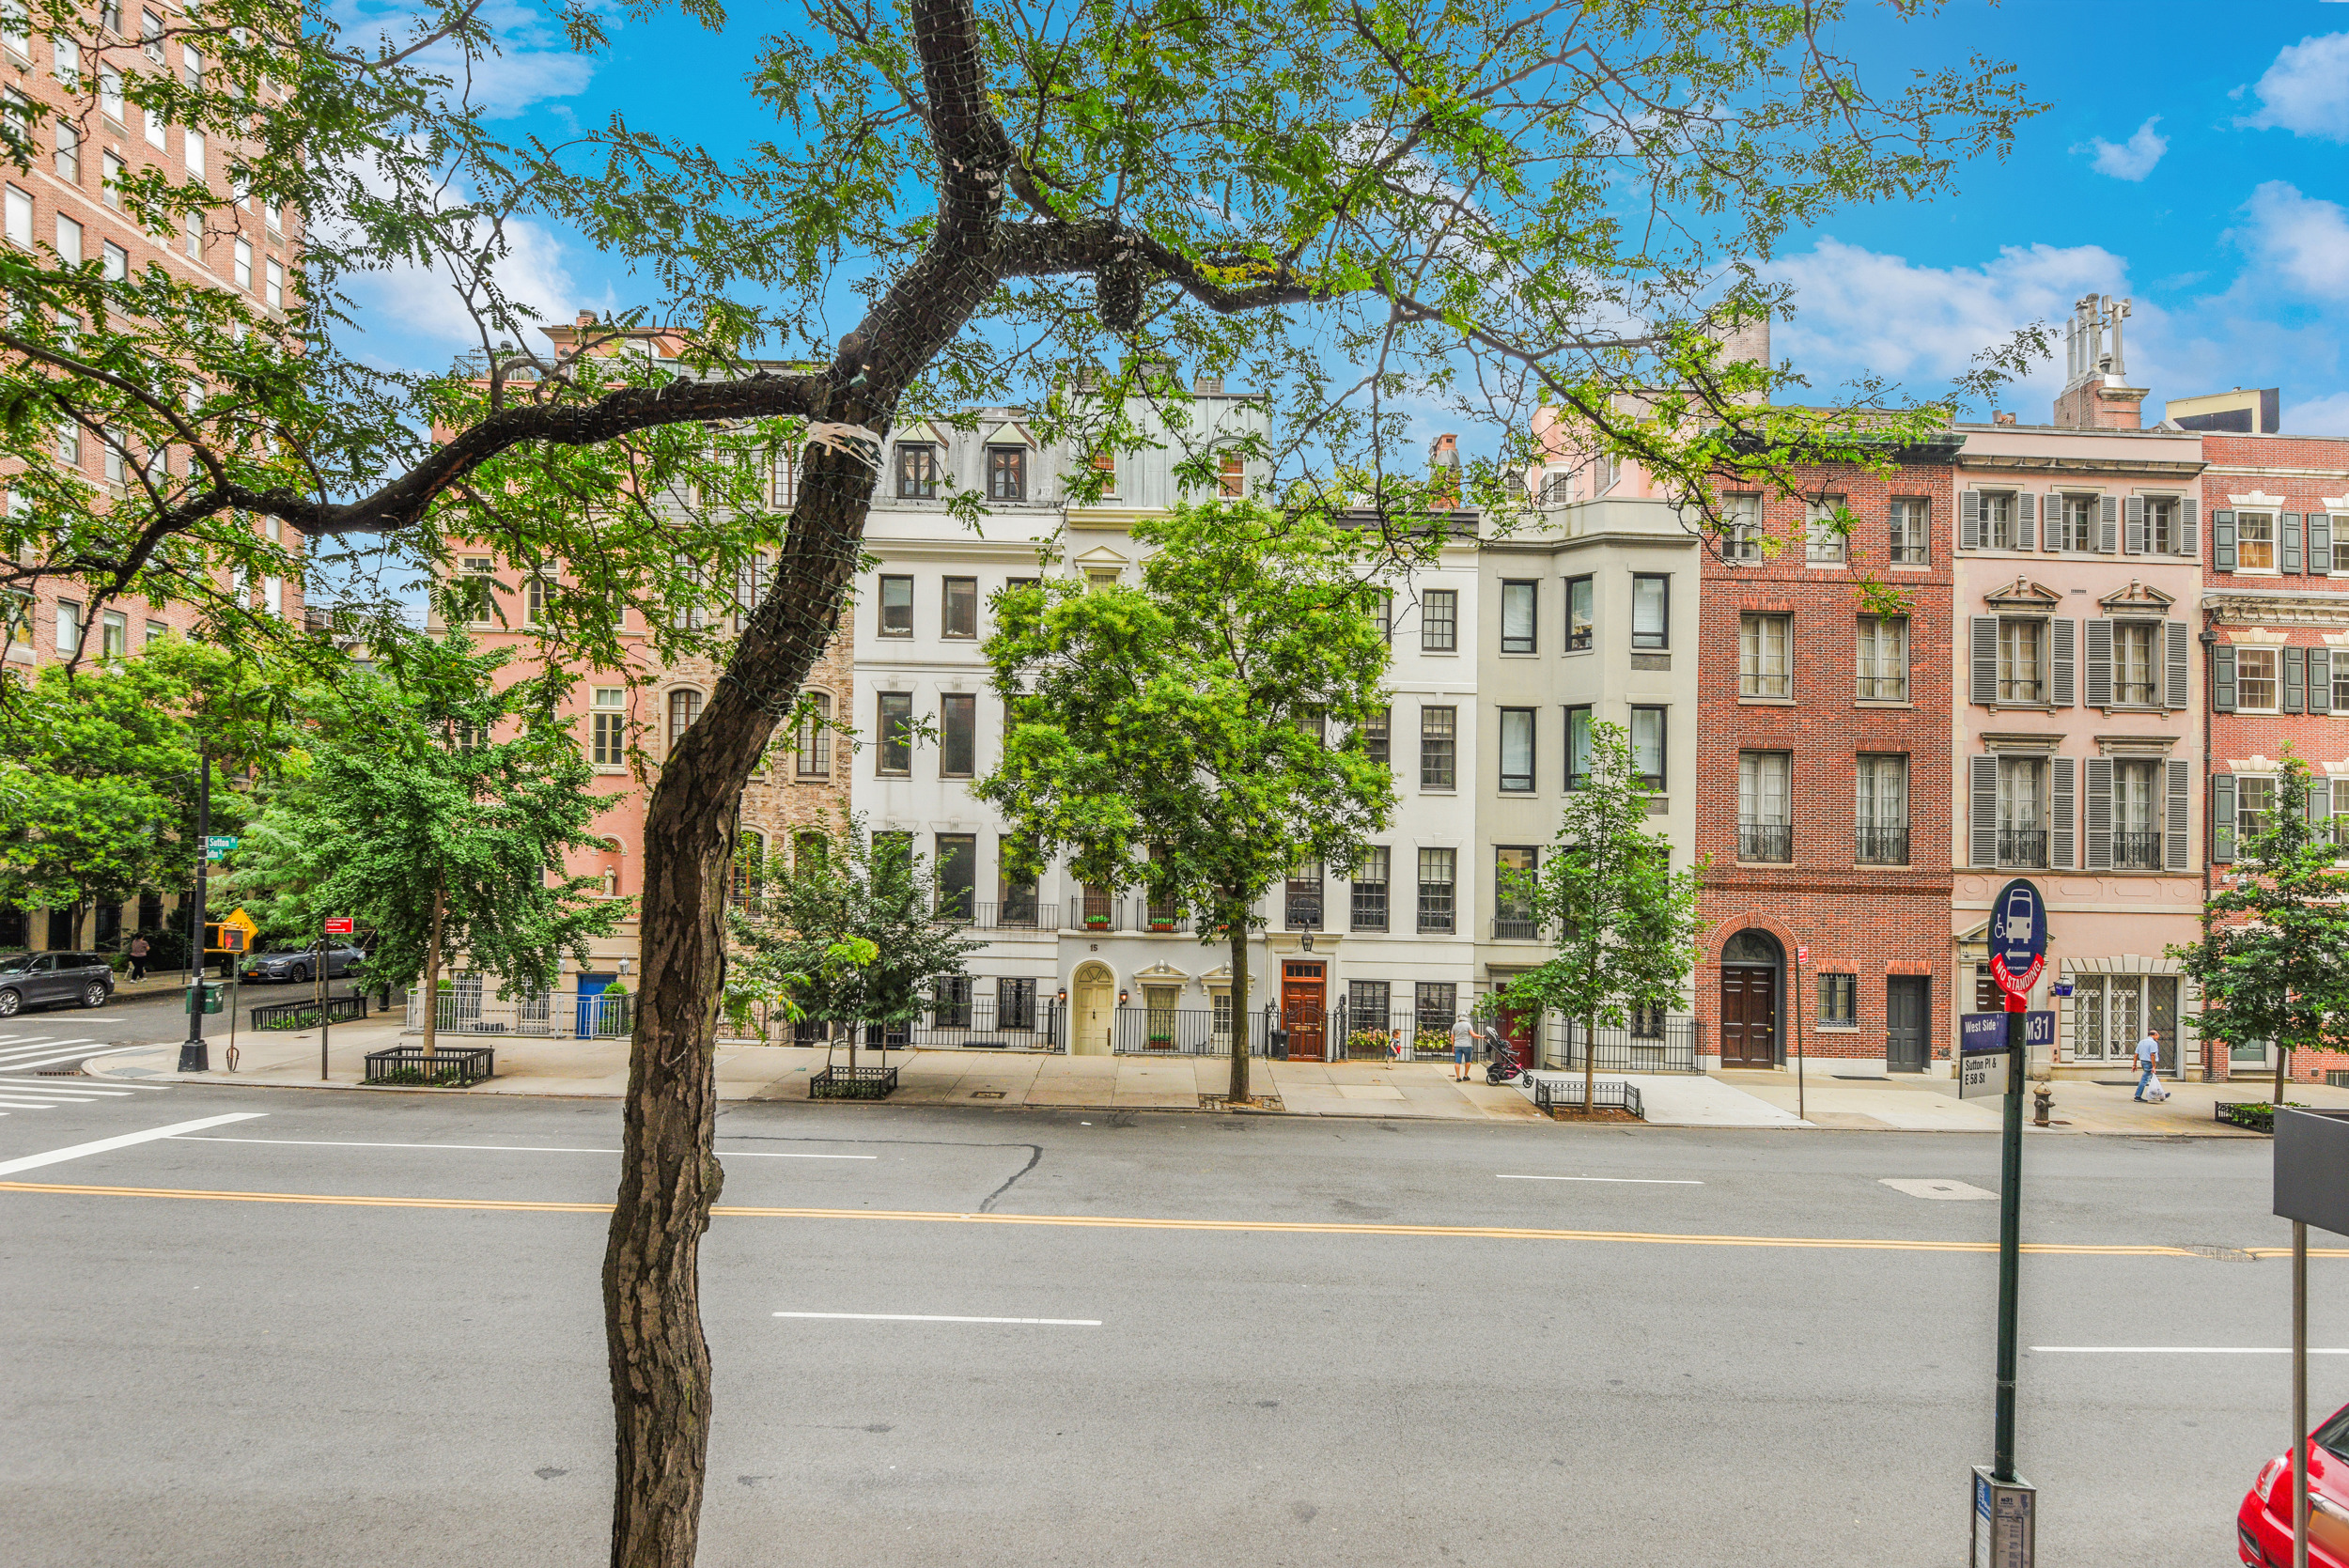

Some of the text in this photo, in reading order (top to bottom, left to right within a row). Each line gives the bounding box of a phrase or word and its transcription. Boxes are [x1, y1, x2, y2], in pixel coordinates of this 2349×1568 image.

[210, 837, 229, 847] Sutton
[1090, 943, 1098, 952] 15
[1996, 960, 2042, 992] NO STANDING
[1965, 1018, 1997, 1033] West Side
[2026, 1016, 2049, 1041] M31
[1965, 1057, 1997, 1071] Sutton Pl &
[1965, 1072, 1985, 1085] E 58 St
